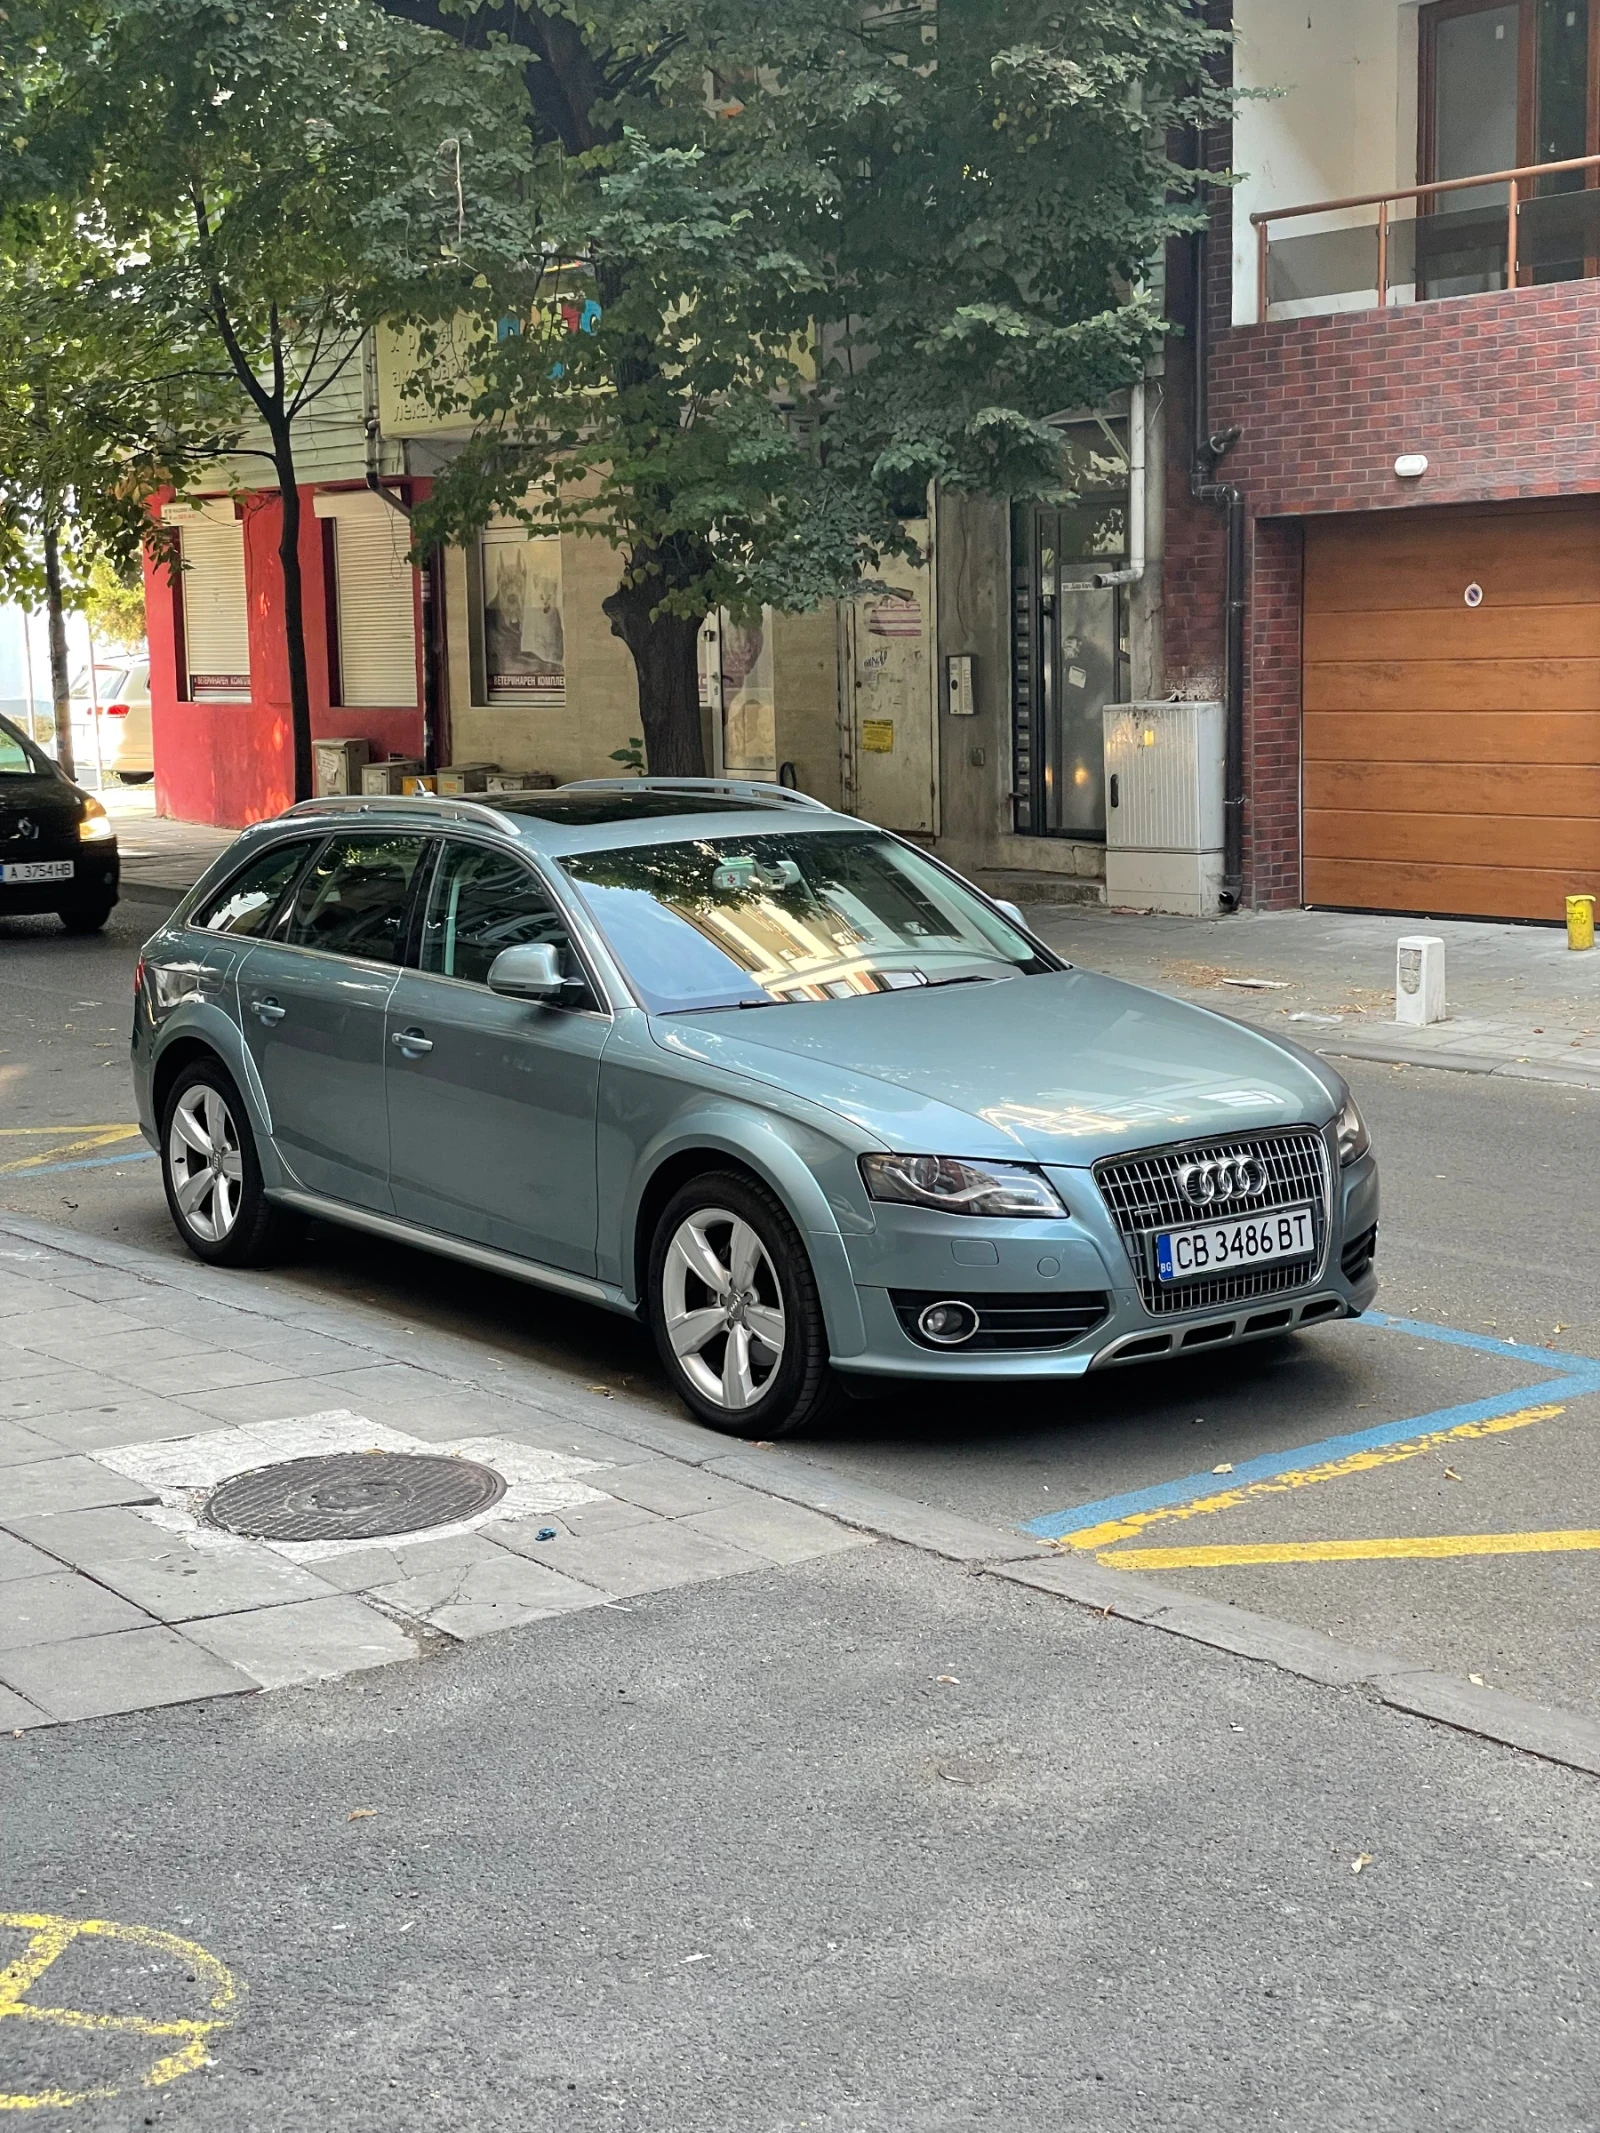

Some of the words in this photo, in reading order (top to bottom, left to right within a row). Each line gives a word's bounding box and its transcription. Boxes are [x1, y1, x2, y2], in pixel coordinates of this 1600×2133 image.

[494, 675, 536, 686] ВЕТЕРИНАРЕН
[10, 867, 18, 878] A
[24, 864, 54, 878] 3754
[55, 862, 71, 876] HB
[1176, 1234, 1210, 1270] CB
[1215, 1221, 1274, 1262] 3486
[1277, 1214, 1307, 1251] BT
[1160, 1261, 1172, 1274] BG
